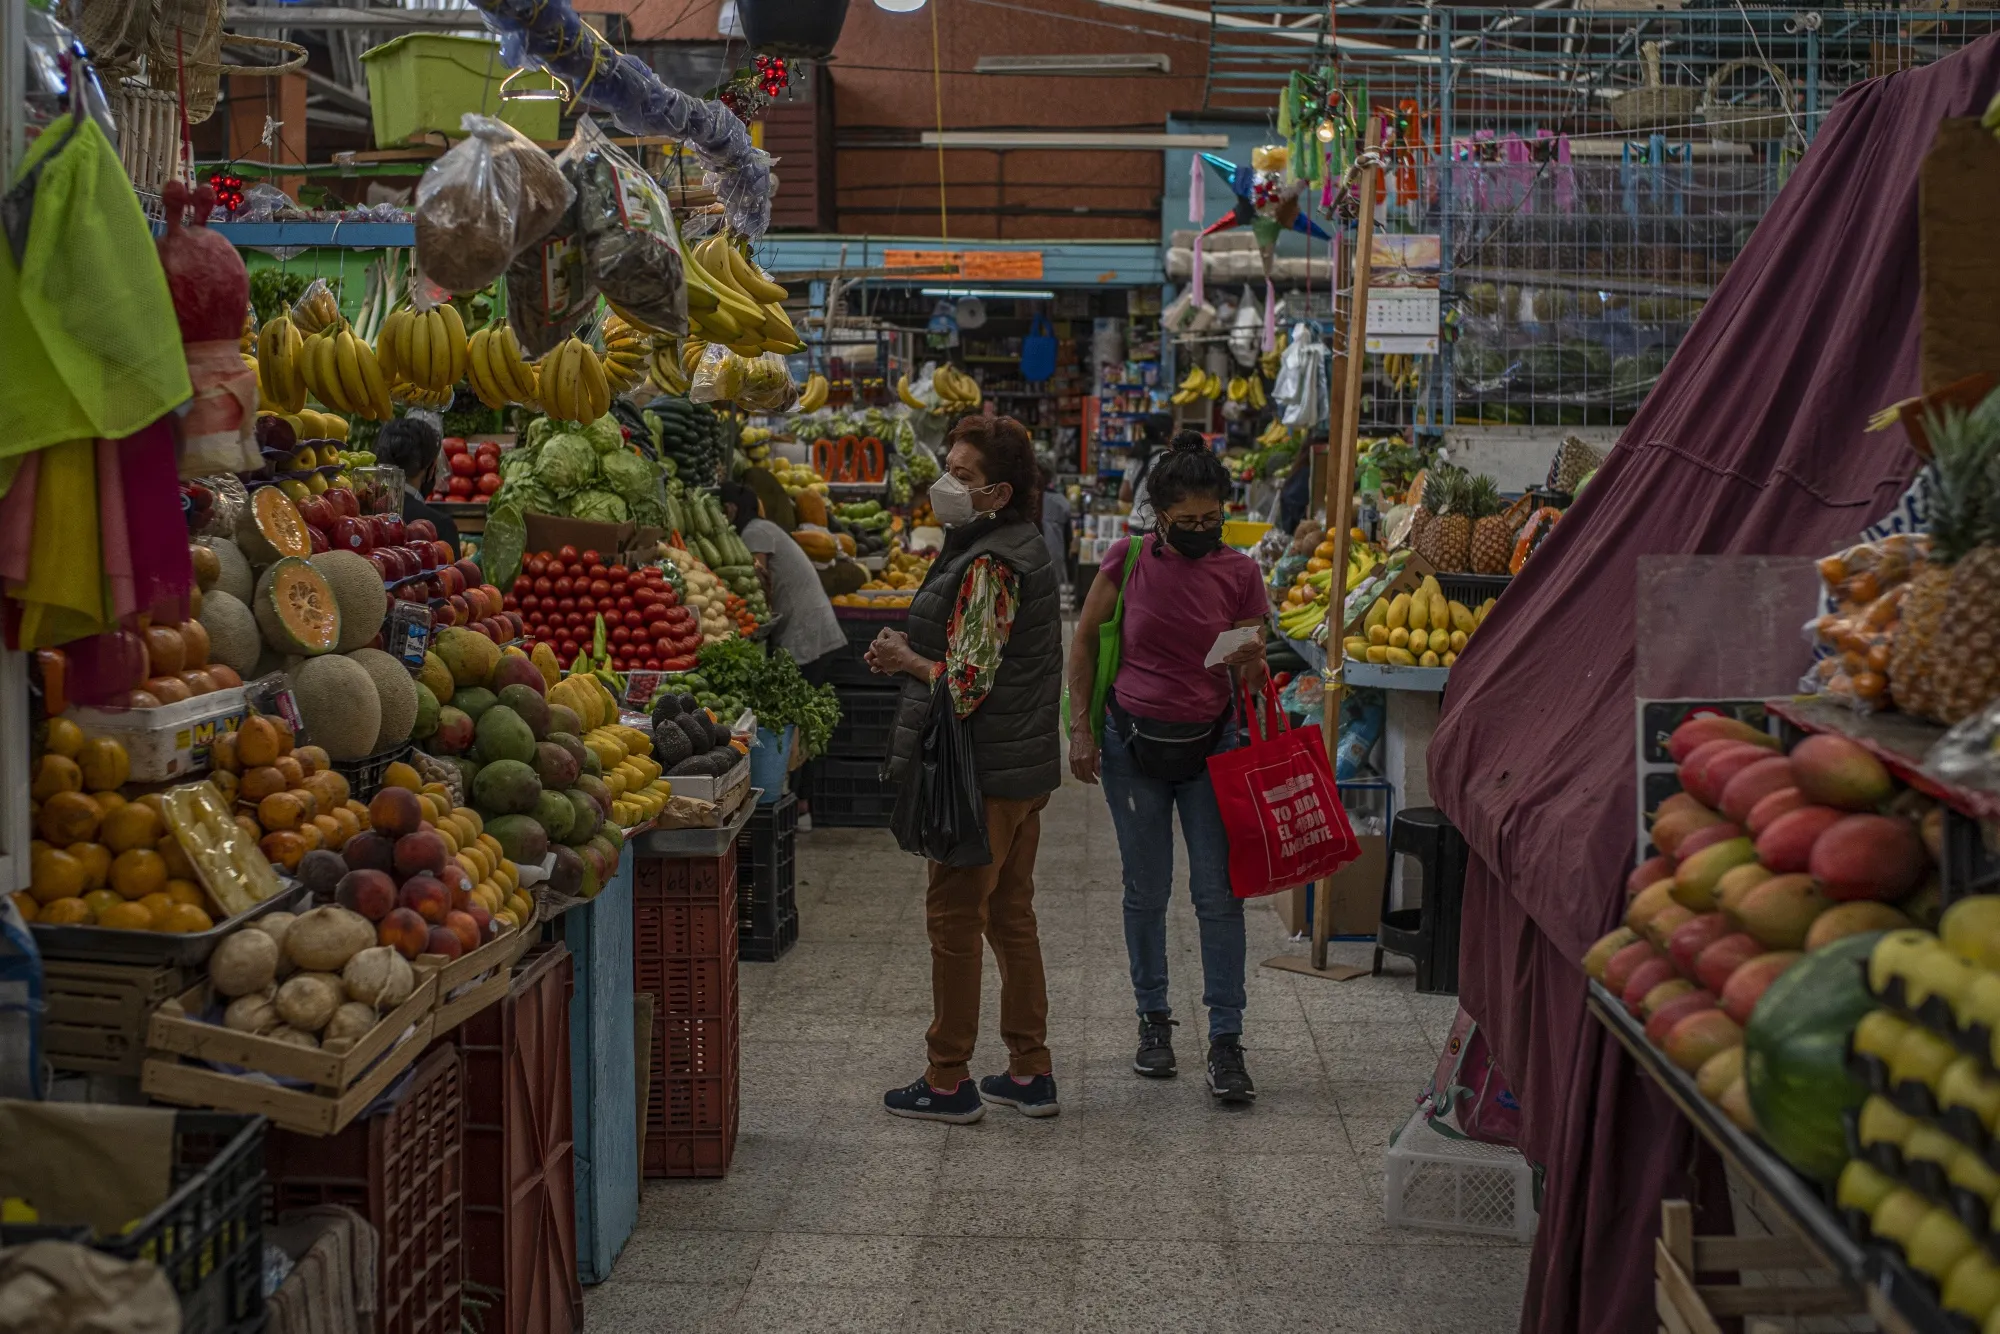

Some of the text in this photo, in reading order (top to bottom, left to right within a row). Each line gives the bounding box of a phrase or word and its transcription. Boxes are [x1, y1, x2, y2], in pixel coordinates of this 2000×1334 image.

[1271, 792, 1320, 823] YO UIDO
[1278, 824, 1293, 841] EL
[1281, 826, 1333, 858] AMBENTE
